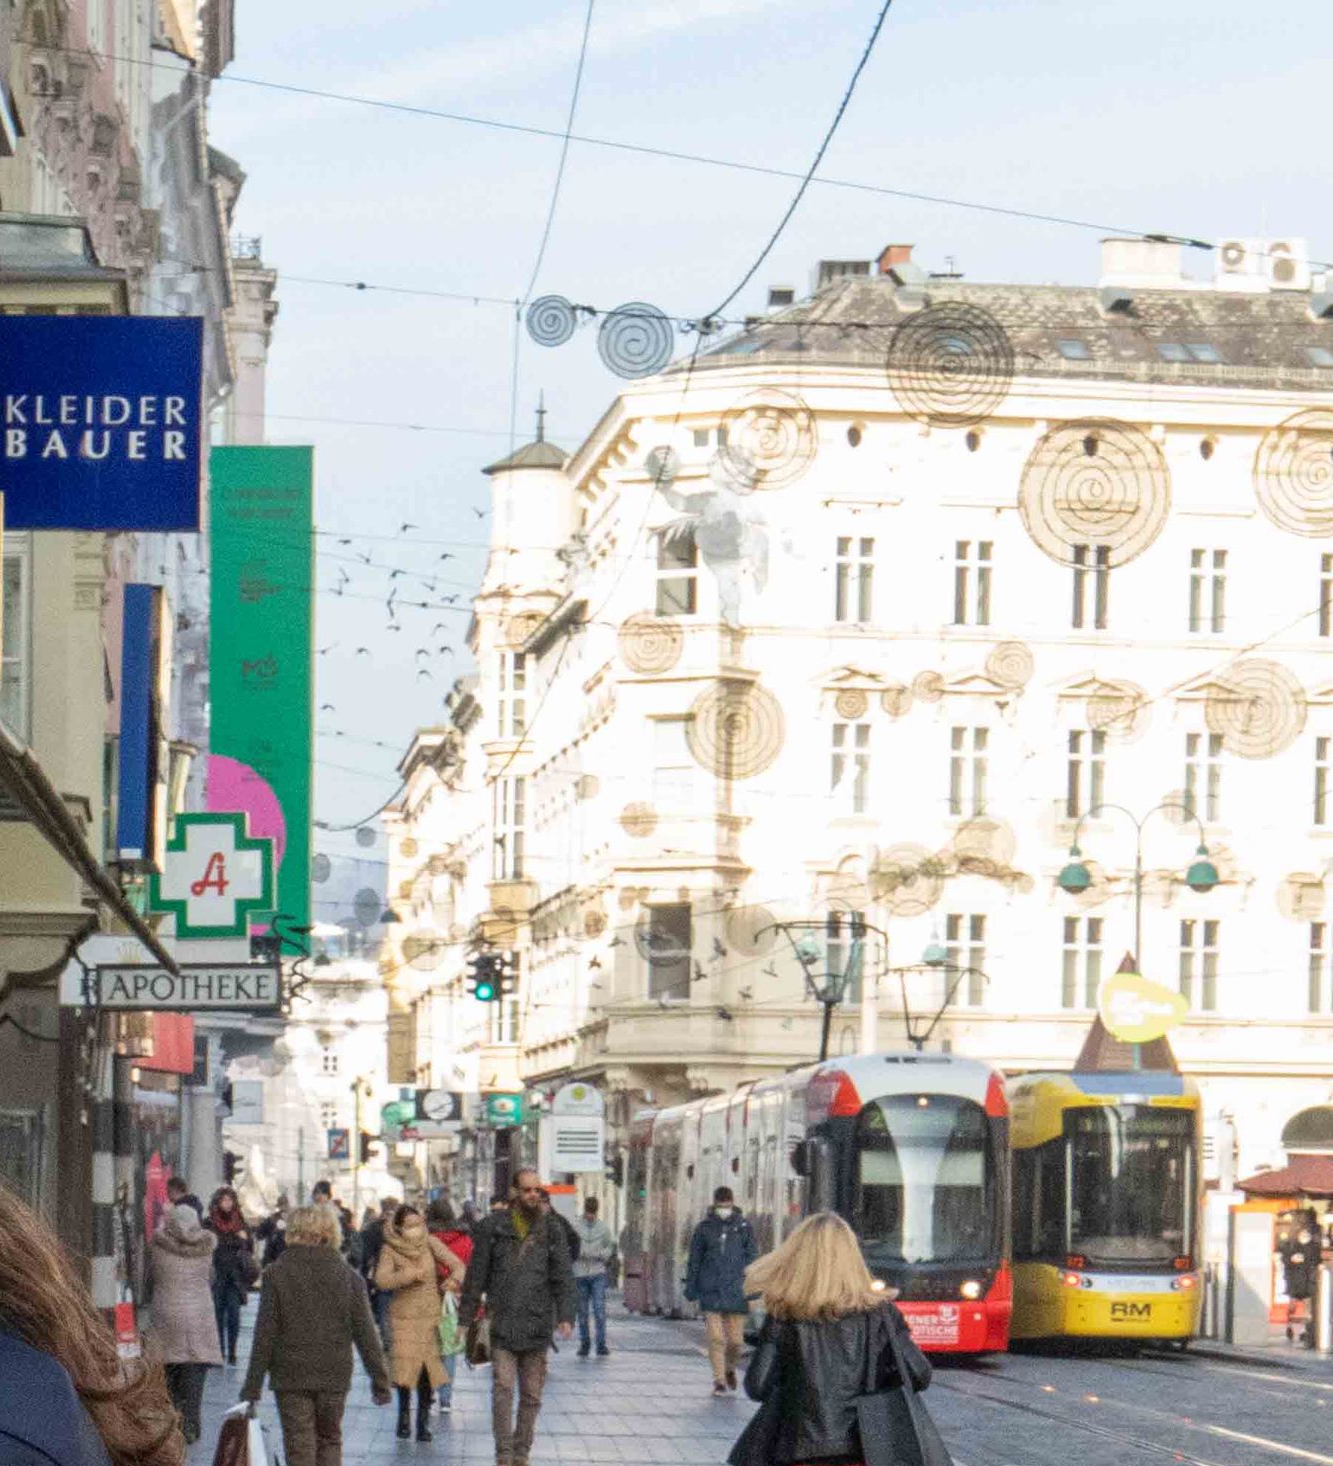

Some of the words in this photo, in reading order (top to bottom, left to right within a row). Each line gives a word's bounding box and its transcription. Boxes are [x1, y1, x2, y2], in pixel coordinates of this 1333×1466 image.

[5, 394, 187, 425] KLEIDER
[4, 429, 187, 460] BAUER
[108, 973, 271, 1001] APOTHEKE
[1110, 1302, 1151, 1317] RM
